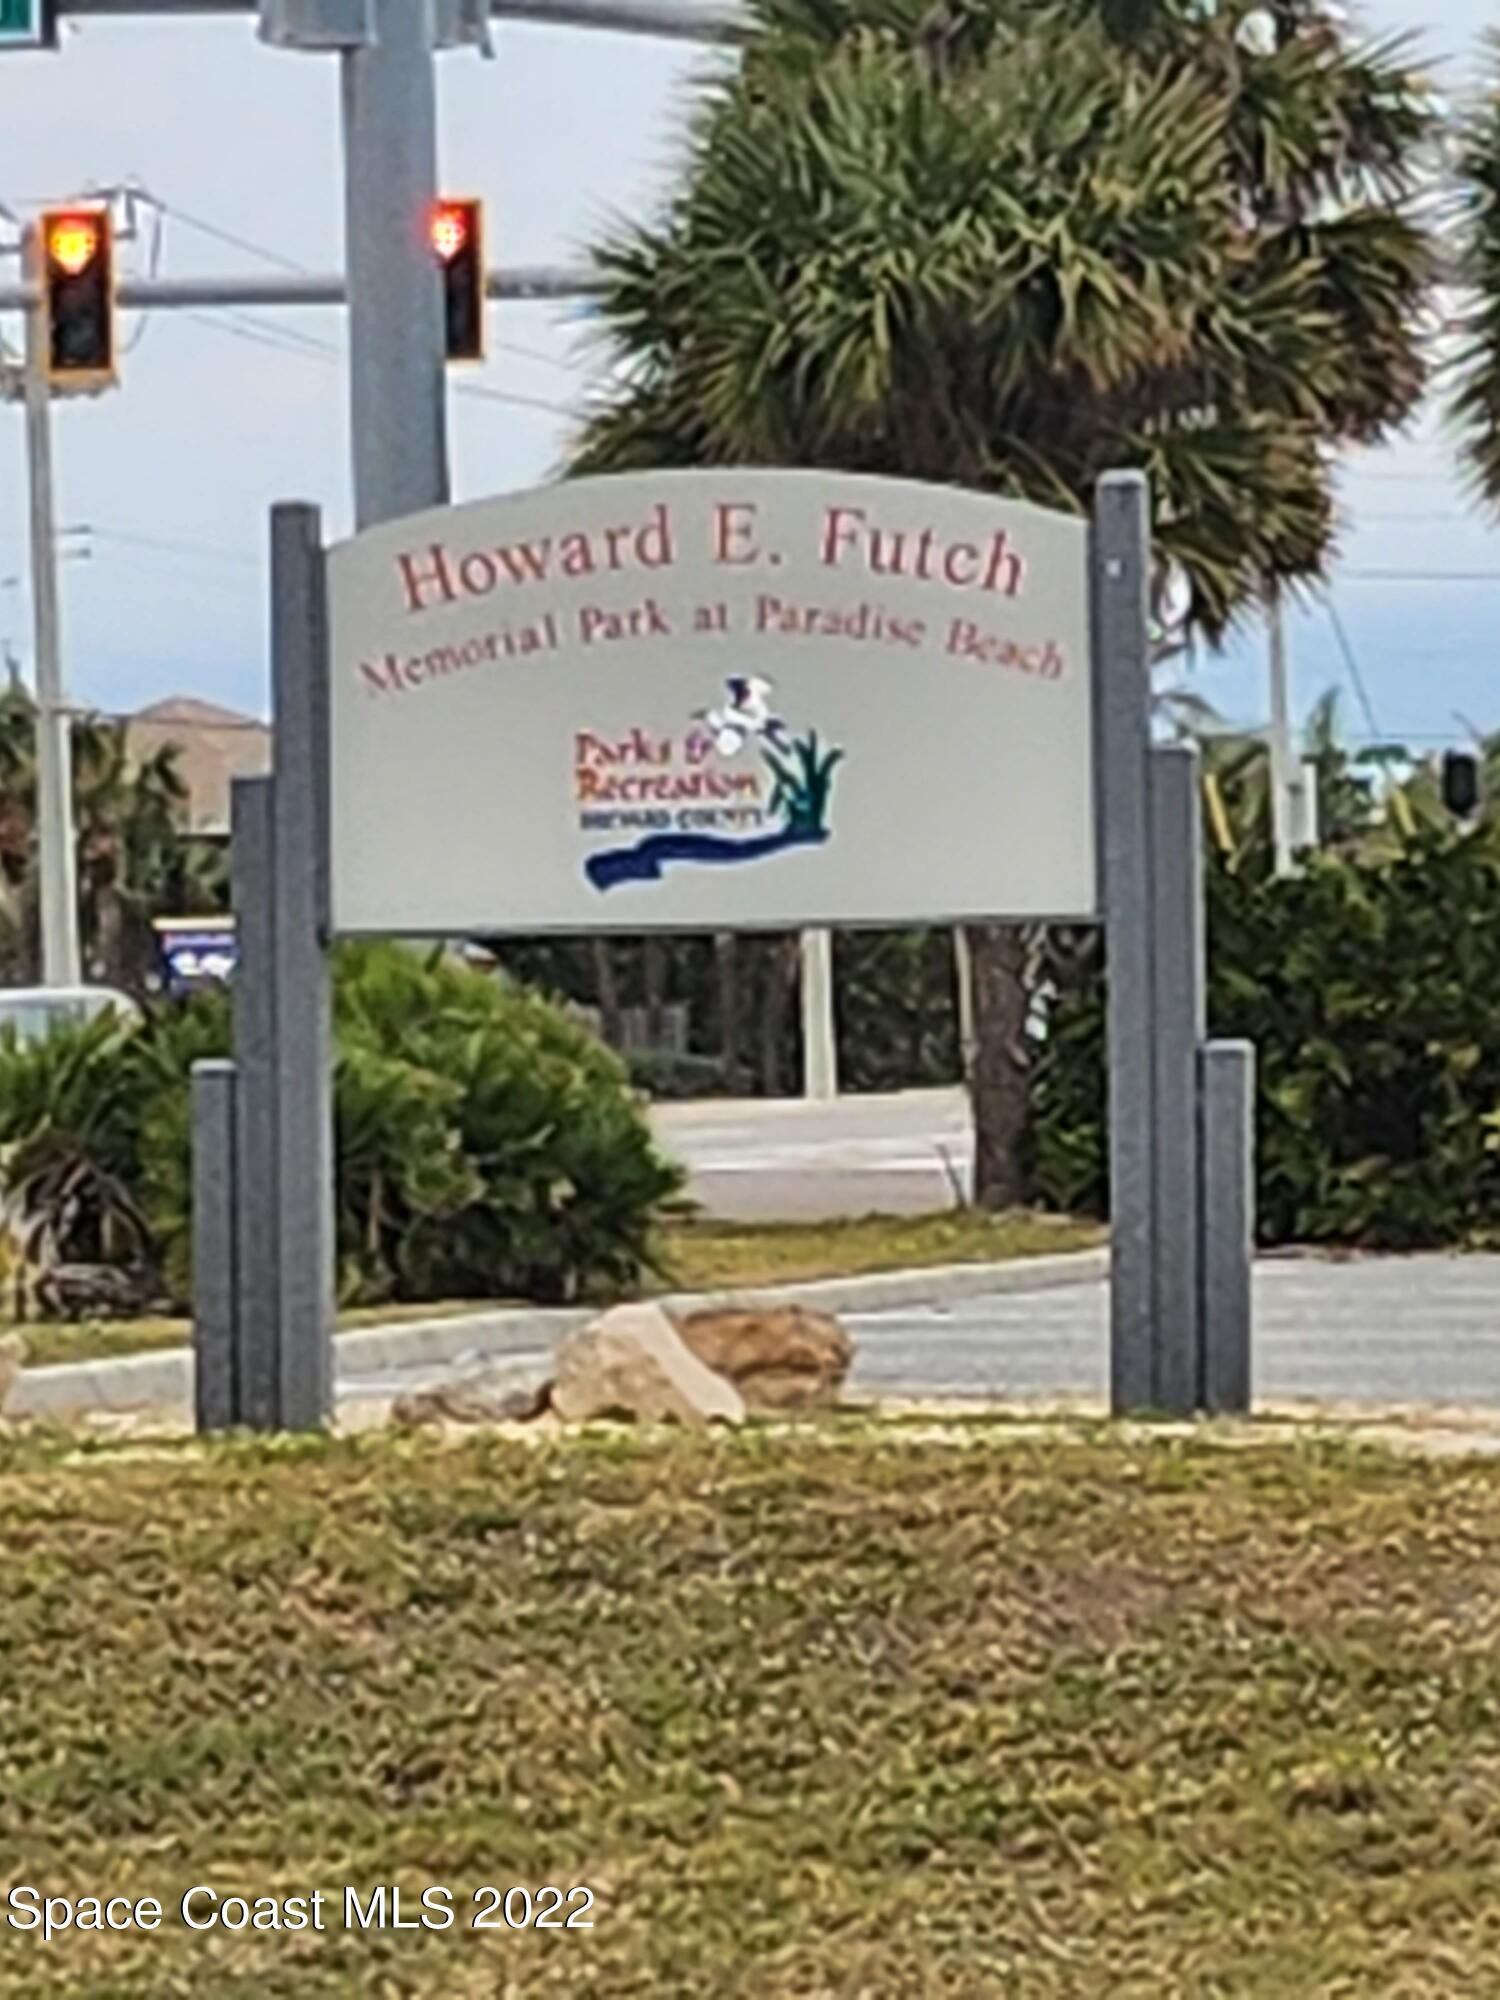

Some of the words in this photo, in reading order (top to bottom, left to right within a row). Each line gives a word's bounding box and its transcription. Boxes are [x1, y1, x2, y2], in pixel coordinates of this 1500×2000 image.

[396, 502, 674, 613] Howard
[714, 502, 782, 565] E.
[821, 505, 1023, 598] Futch
[358, 612, 559, 692] Memorial
[577, 597, 671, 643] Park
[693, 602, 728, 632] at
[755, 594, 926, 648] Paradise
[945, 618, 1065, 682] Beach
[575, 728, 671, 765] Parks
[575, 768, 760, 801] Recreation
